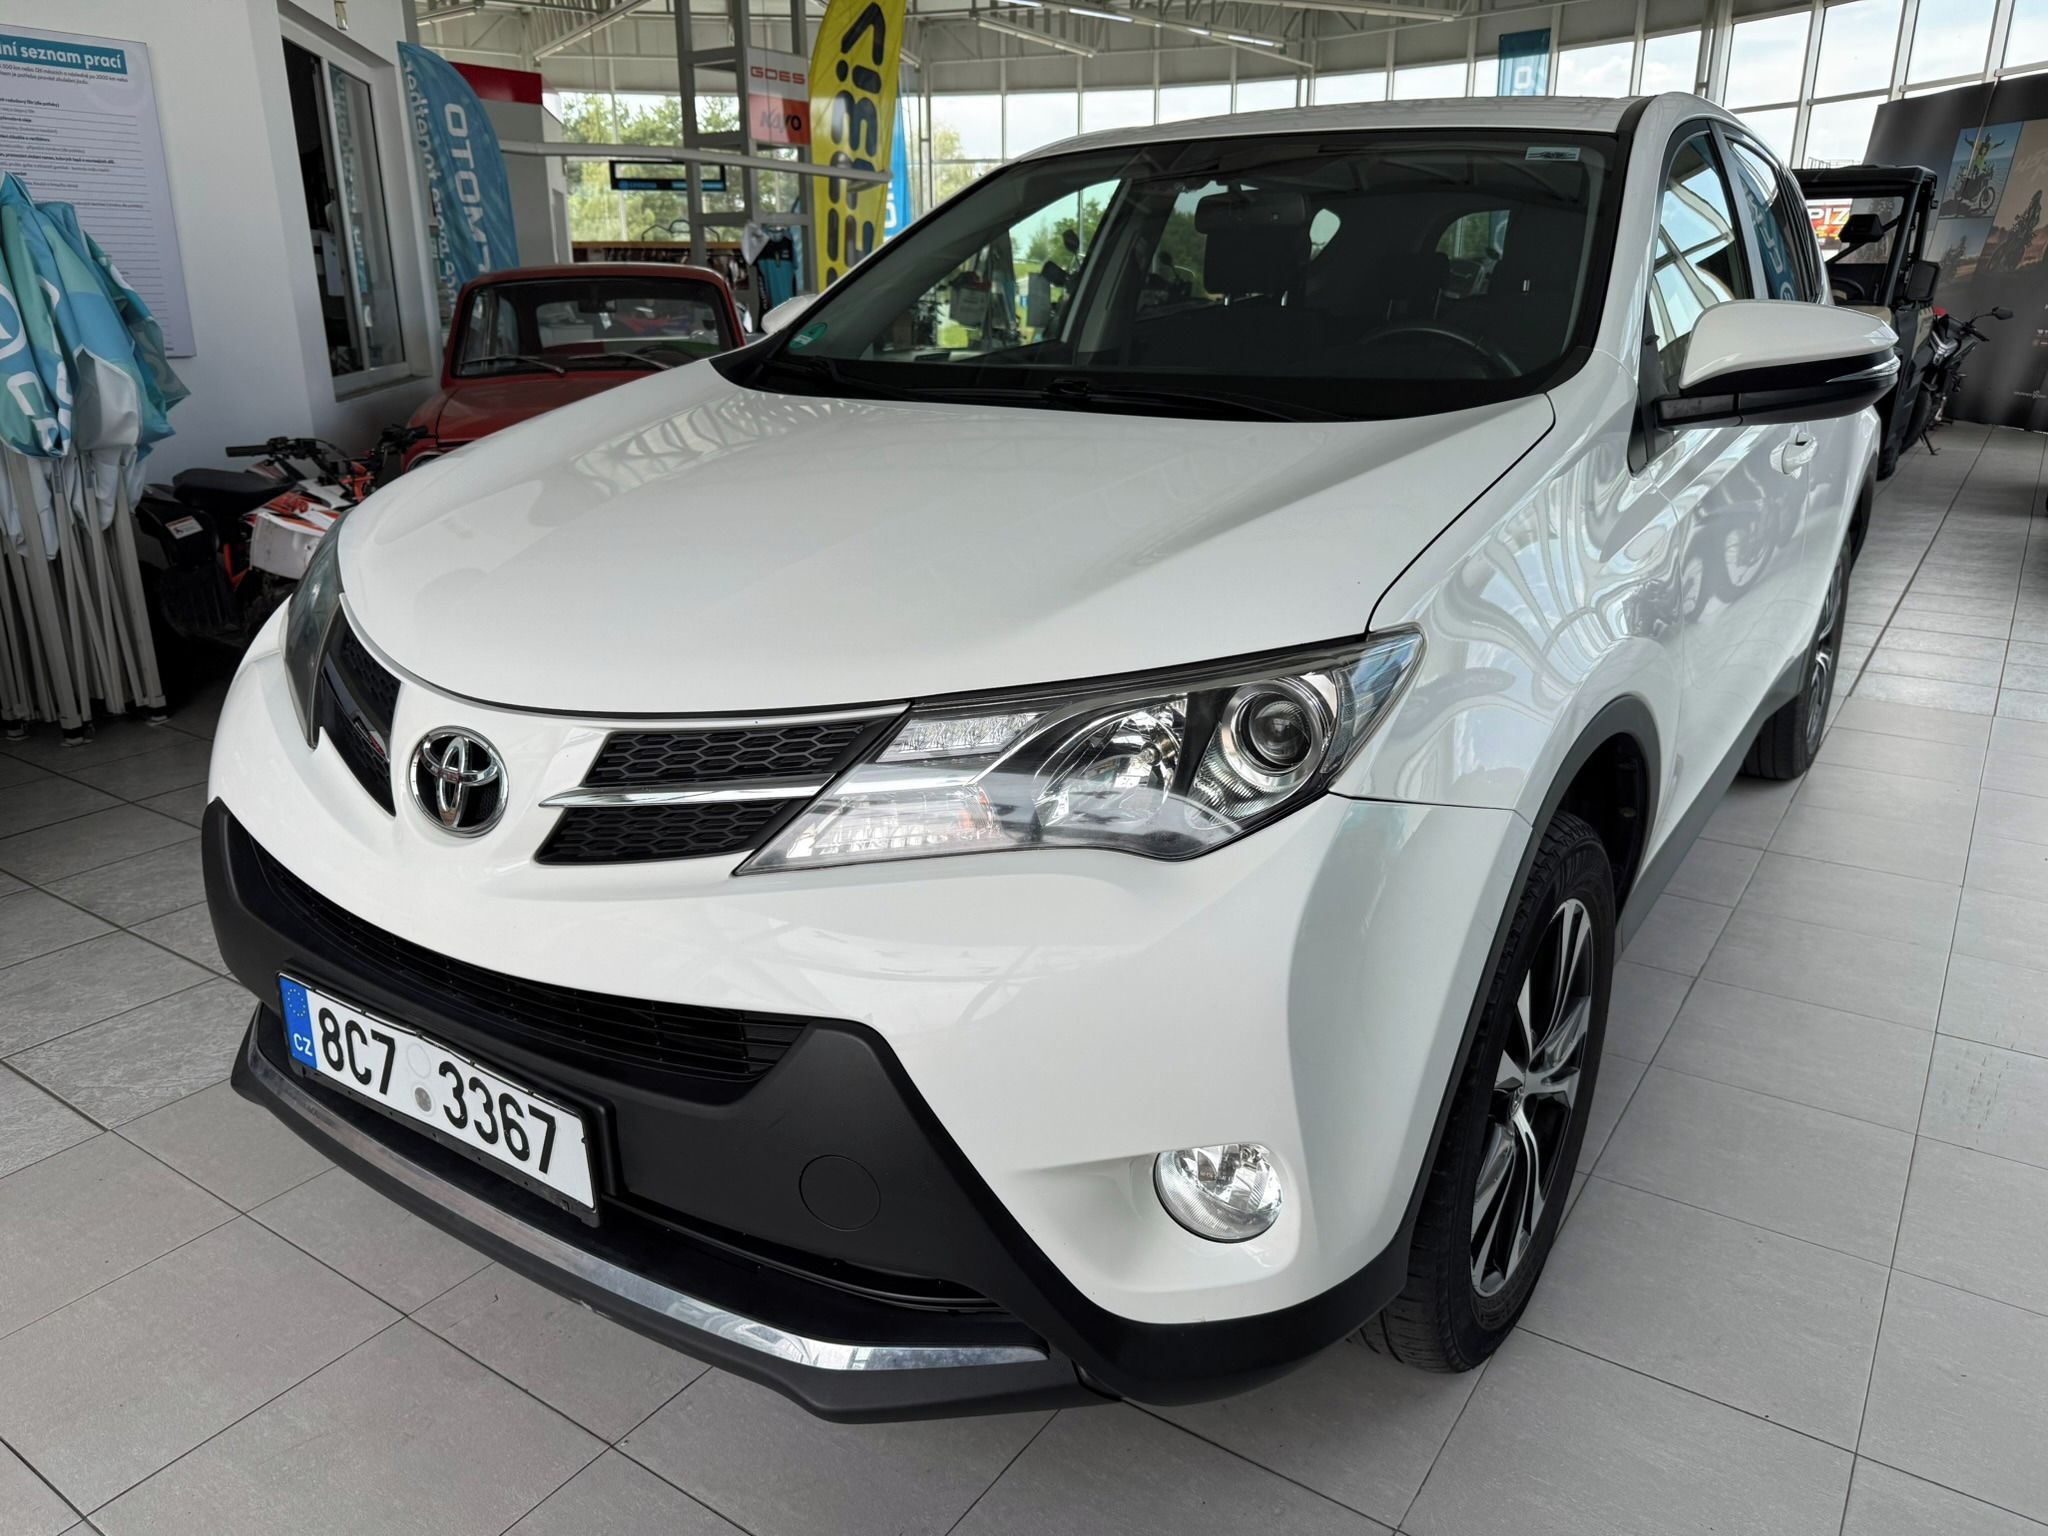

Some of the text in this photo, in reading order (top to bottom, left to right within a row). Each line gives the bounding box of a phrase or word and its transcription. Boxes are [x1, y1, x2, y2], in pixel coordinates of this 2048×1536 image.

[20, 46, 81, 64] seznam
[84, 54, 121, 69] prací
[750, 66, 805, 85] GOES
[293, 1033, 313, 1057] CZ
[318, 1007, 557, 1175] 8C7 3367
